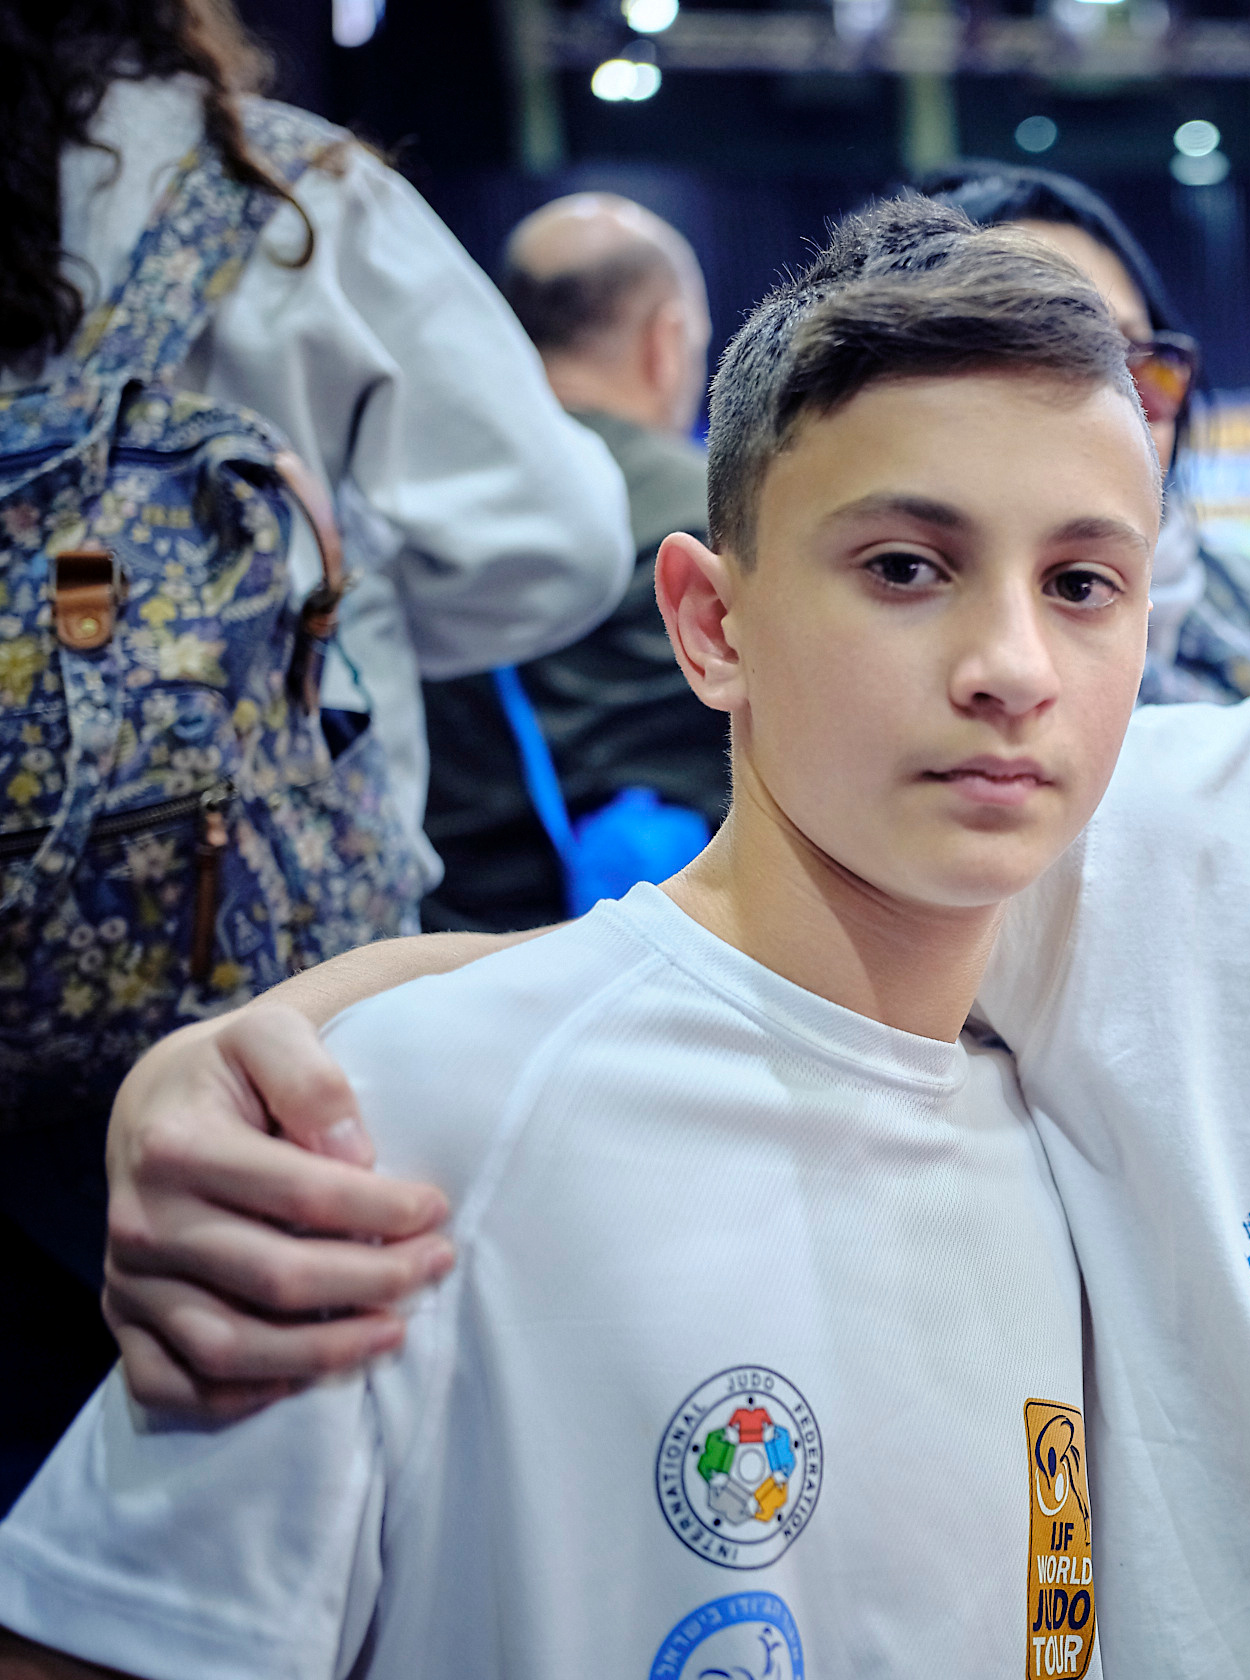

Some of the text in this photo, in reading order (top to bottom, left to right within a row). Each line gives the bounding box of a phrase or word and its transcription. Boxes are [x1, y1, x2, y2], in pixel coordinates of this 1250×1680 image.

[663, 1373, 818, 1560] INTERNATIONAL JUDO FEDERATION
[1050, 1521, 1075, 1551] IJF
[1036, 1554, 1093, 1586] WORLD
[1032, 1588, 1091, 1632] JUDO
[1032, 1634, 1083, 1677] TOUR
